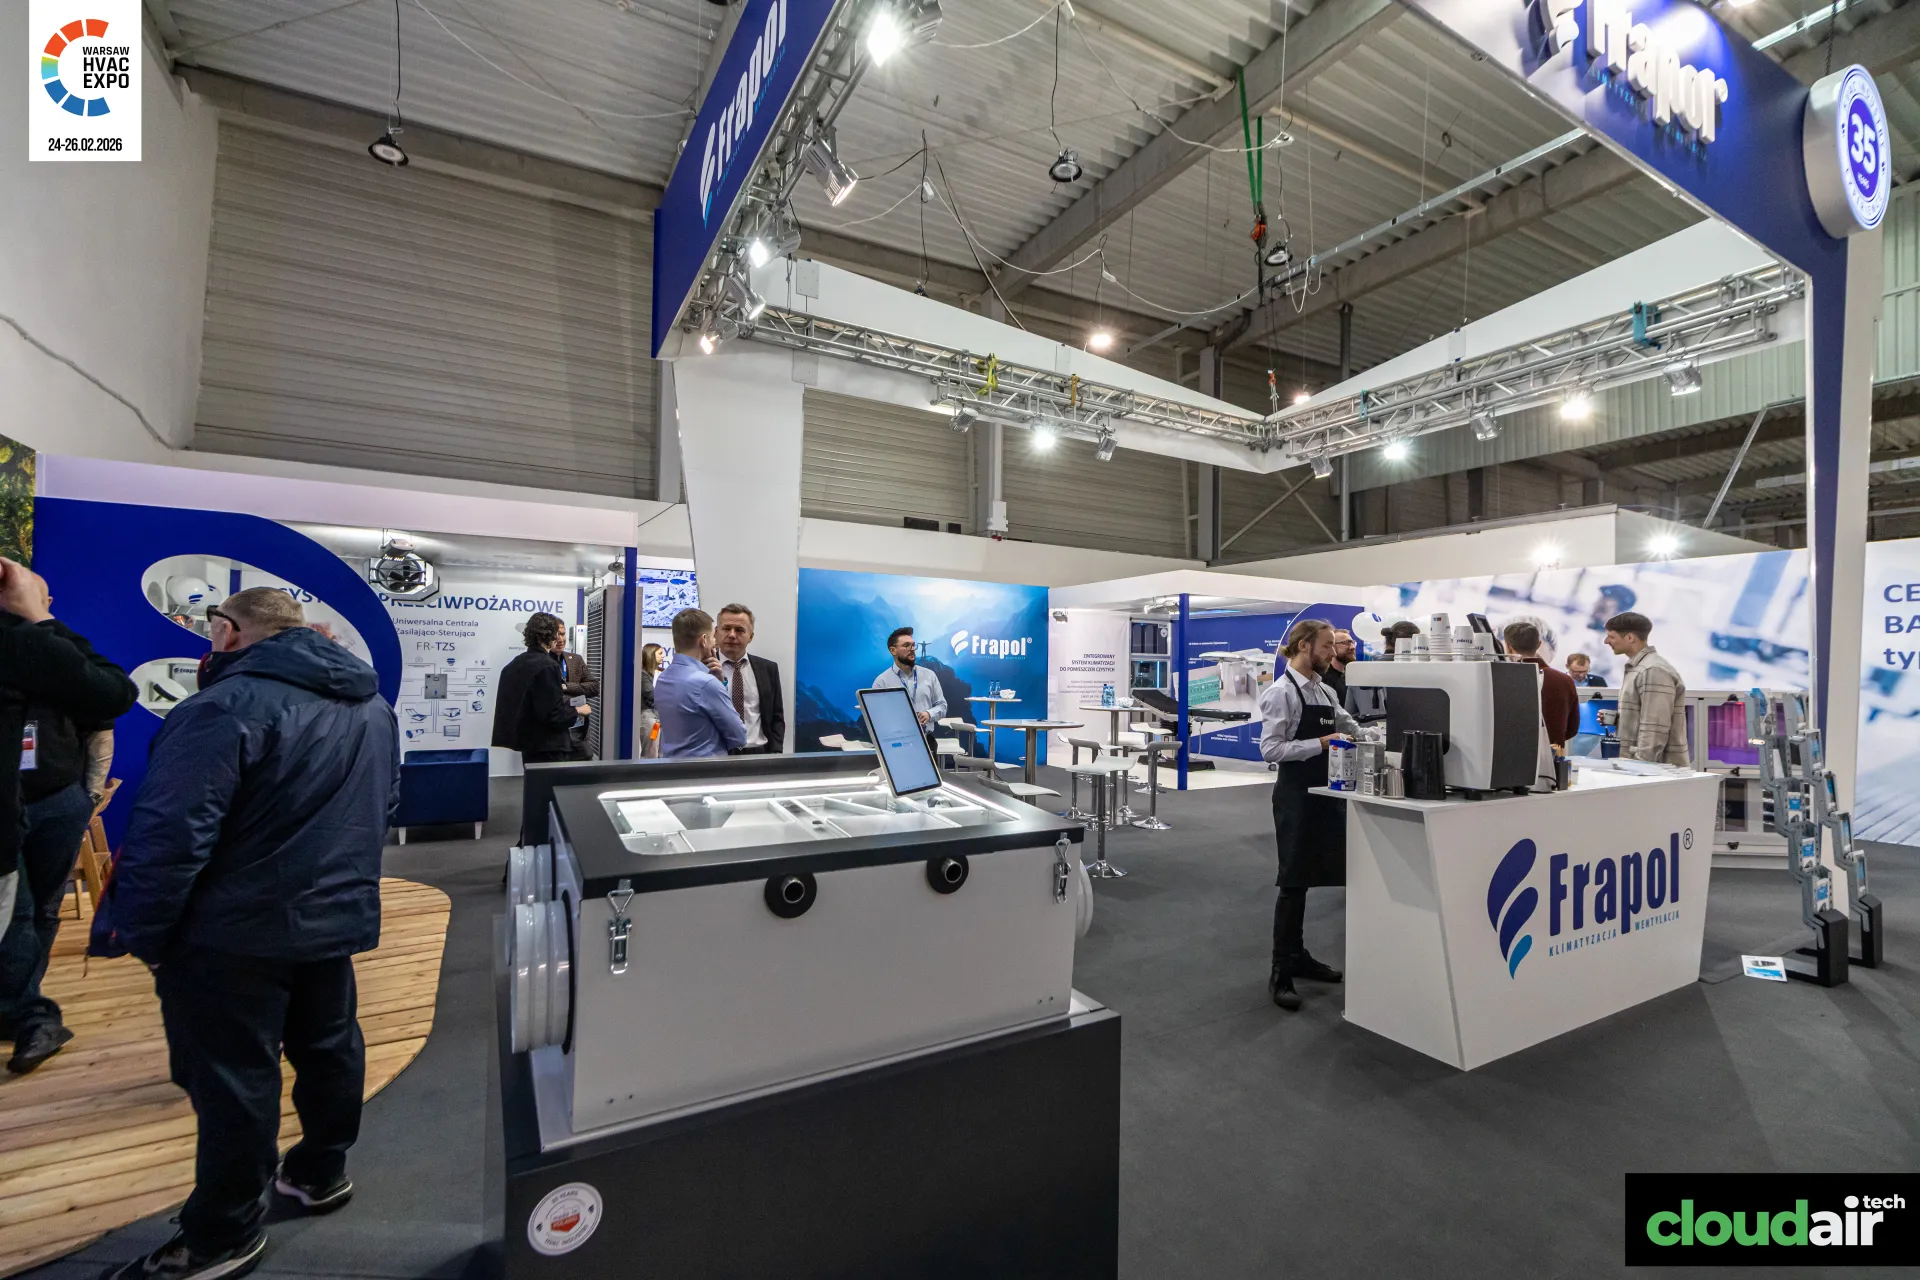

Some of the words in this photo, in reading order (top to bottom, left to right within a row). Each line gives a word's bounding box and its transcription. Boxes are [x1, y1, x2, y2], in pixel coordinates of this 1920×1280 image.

[1850, 112, 1876, 174] 35
[378, 592, 564, 614] PIWPOŻAROWE
[392, 617, 444, 627] Uniwersalna
[445, 619, 479, 627] Centrala
[416, 641, 456, 652] FR-TZS
[1883, 648, 1920, 670] ty
[1548, 928, 1617, 957] KLIMATYZACJA
[1634, 910, 1680, 931] WENTYLACJA
